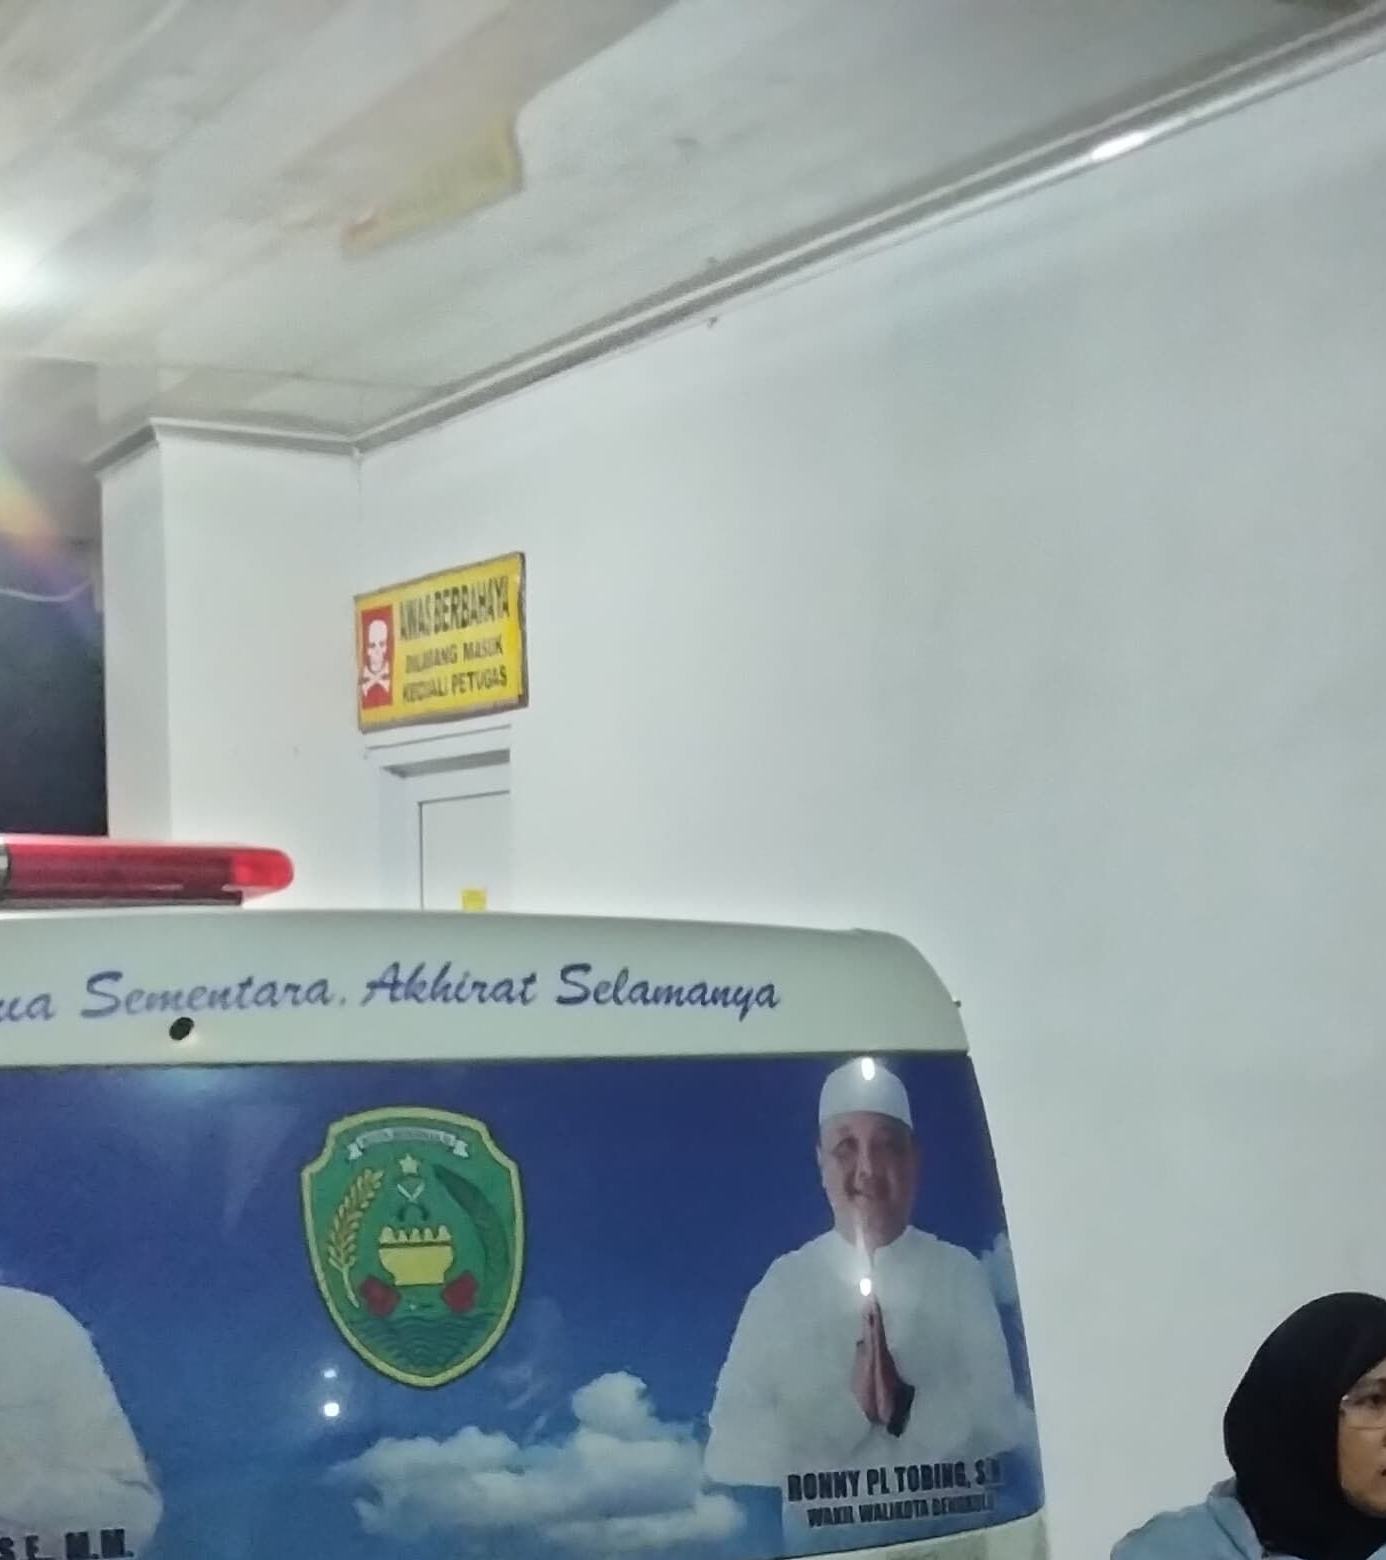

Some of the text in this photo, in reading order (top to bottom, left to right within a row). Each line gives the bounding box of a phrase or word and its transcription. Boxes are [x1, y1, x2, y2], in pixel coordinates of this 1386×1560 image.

[434, 575, 511, 634] BERBAHAYA
[463, 635, 504, 662] MASUK
[451, 666, 508, 695] PETUGAS
[359, 961, 537, 1007] Akhirat
[555, 963, 781, 1022] Selamanya
[866, 1467, 890, 1496] PL
